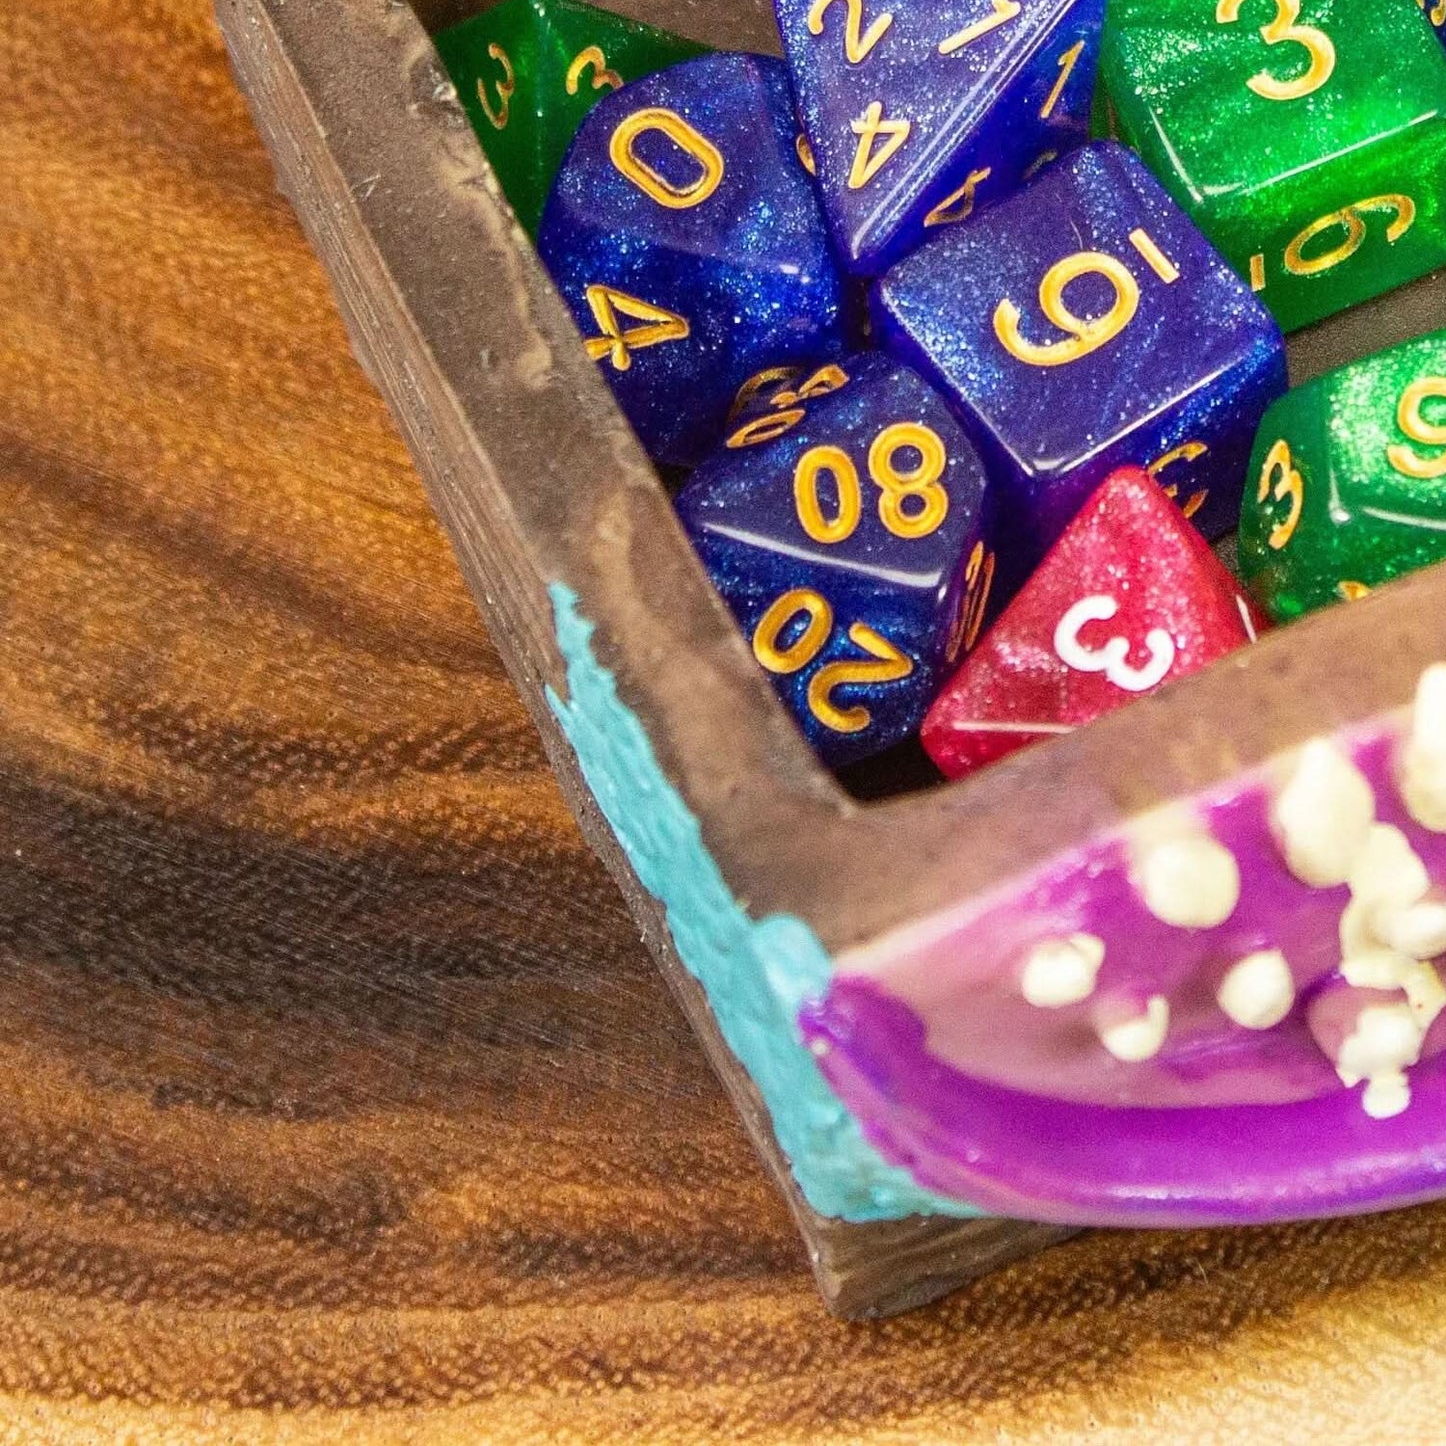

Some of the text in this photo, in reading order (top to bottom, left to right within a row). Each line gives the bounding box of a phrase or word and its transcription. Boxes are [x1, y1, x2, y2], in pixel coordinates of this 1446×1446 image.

[477, 42, 515, 130] 3
[1040, 39, 1085, 119] 1
[609, 107, 724, 210] 0
[848, 101, 911, 189] 4
[582, 285, 690, 372] 4
[793, 422, 950, 544] 80
[1257, 439, 1303, 550] 3
[752, 588, 914, 734] 20
[1054, 595, 1174, 692] 3
